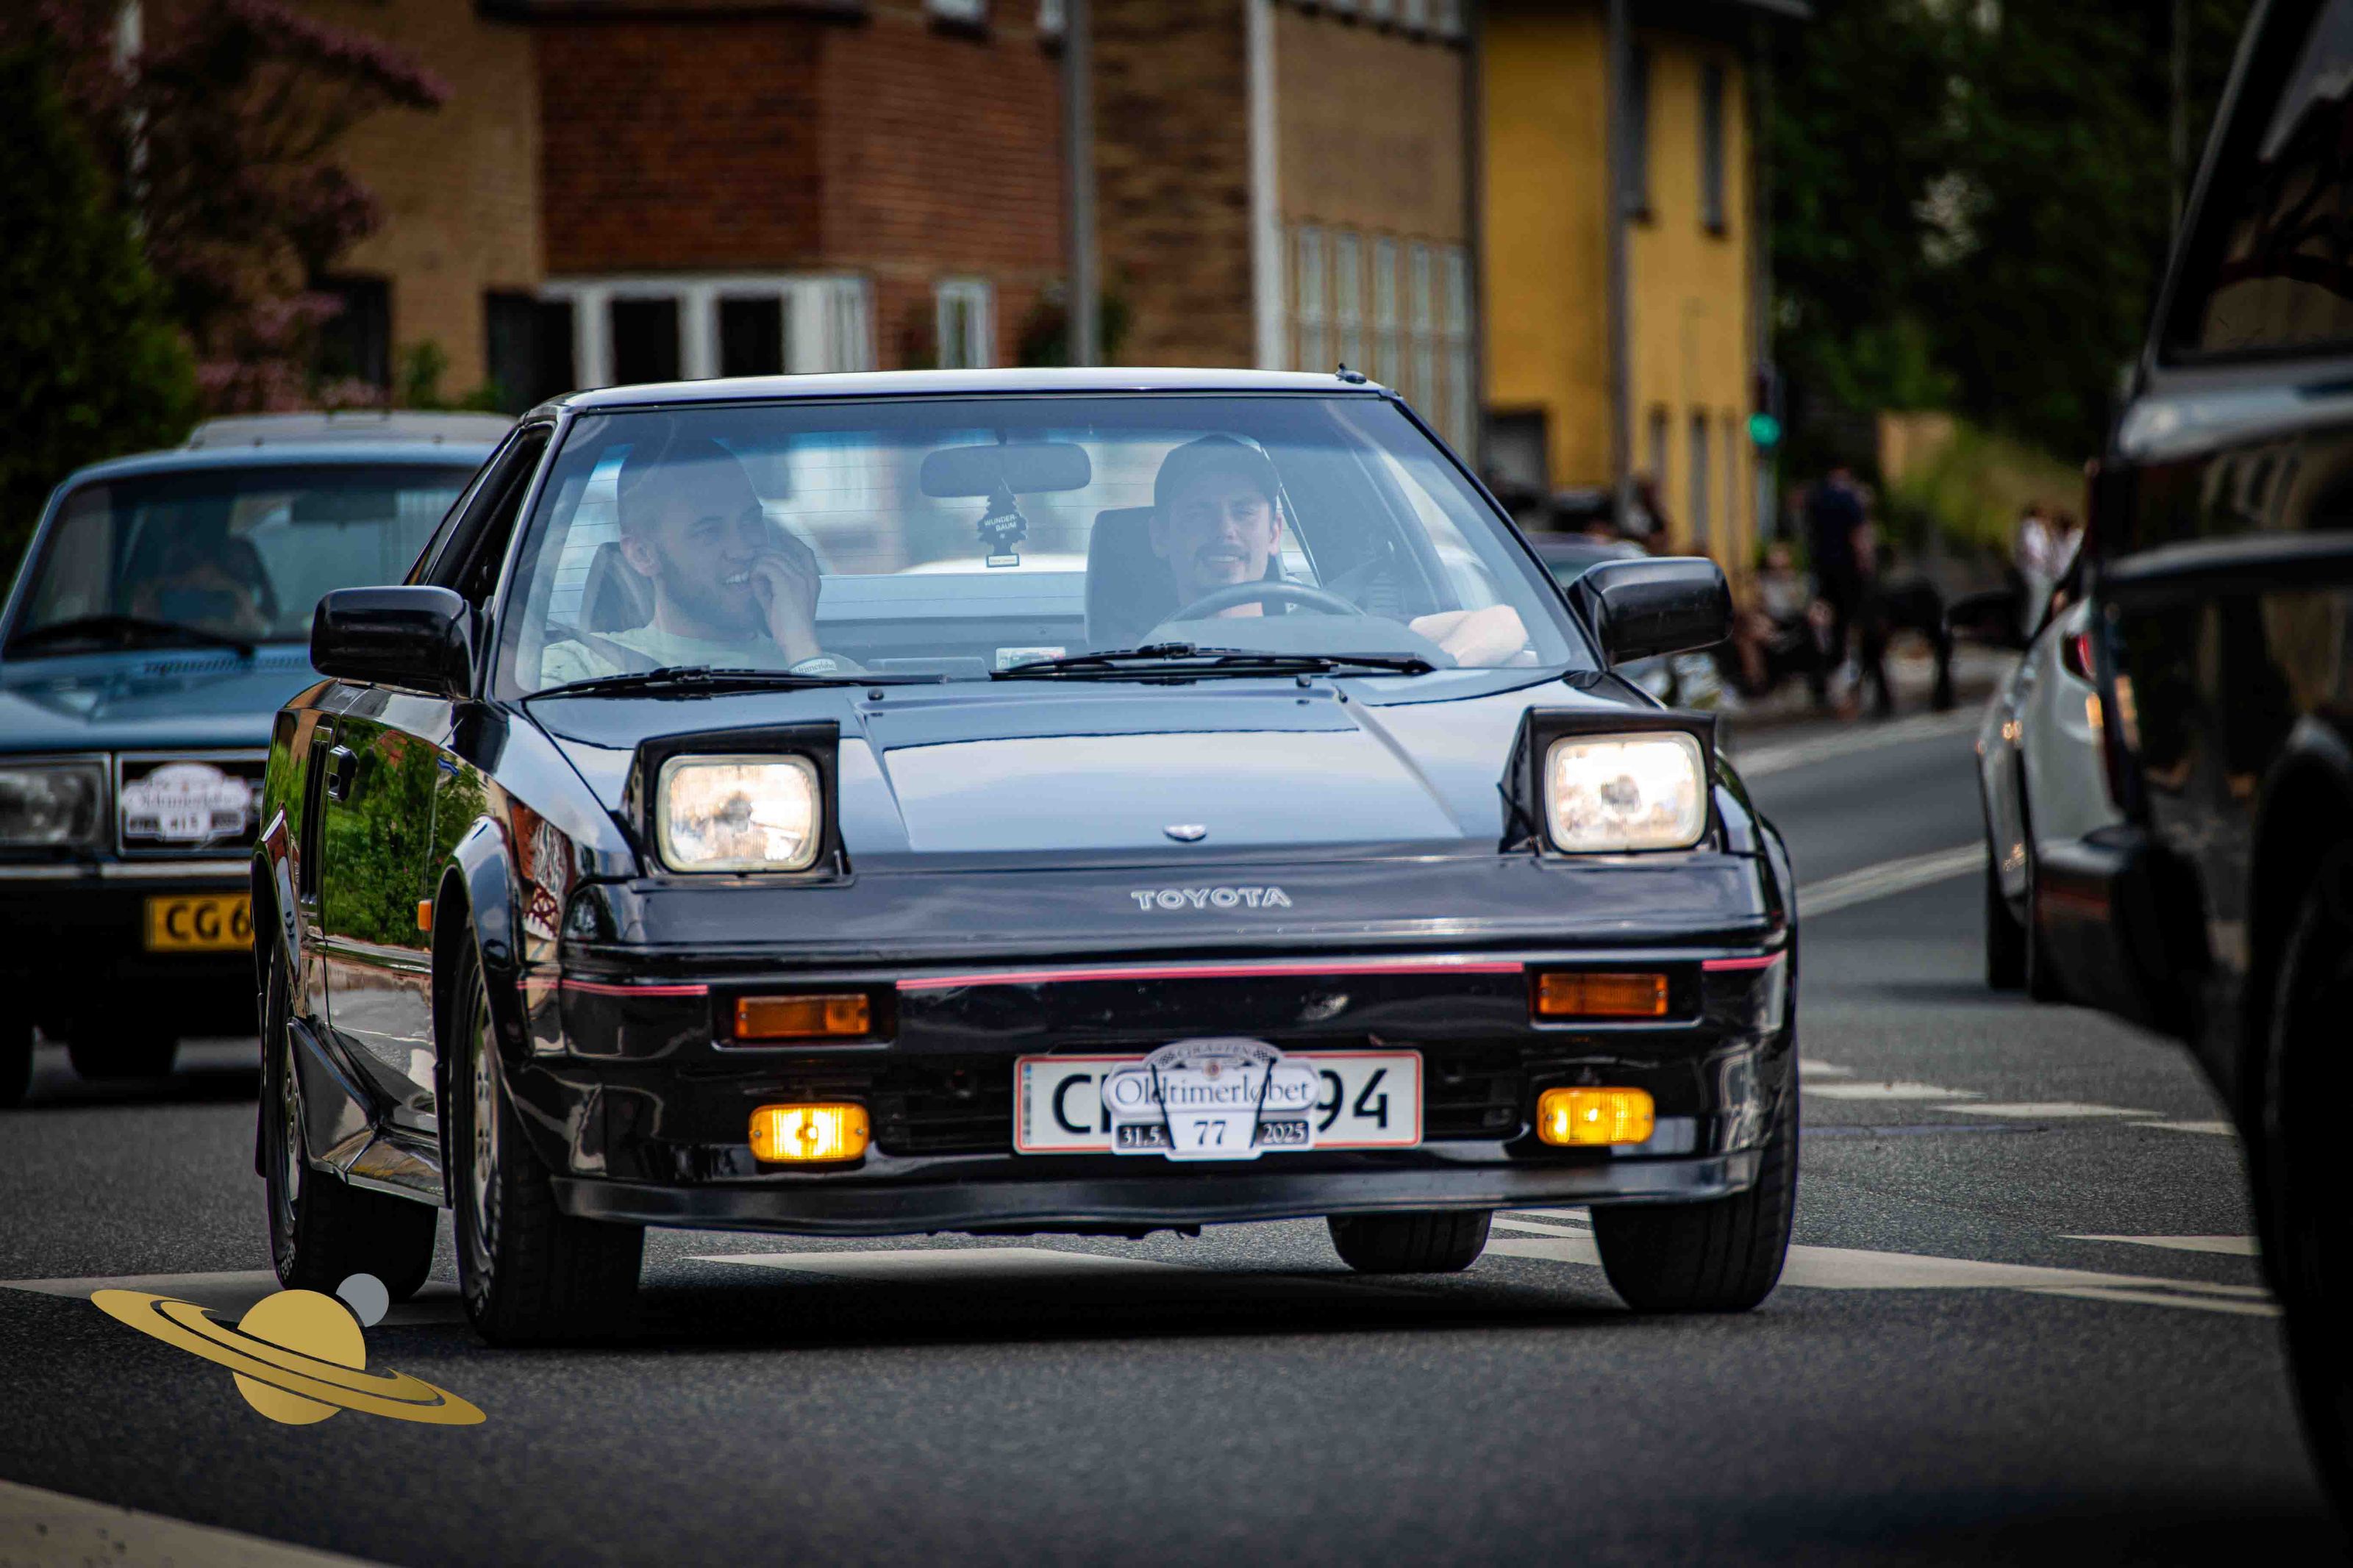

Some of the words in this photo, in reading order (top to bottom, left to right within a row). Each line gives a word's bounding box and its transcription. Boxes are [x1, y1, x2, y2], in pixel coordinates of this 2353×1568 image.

[984, 514, 1018, 526] WUNDER-
[995, 521, 1017, 531] BAUM
[1131, 887, 1293, 911] TOYOTA
[165, 901, 221, 940] CG
[1315, 1068, 1388, 1133] 94
[1193, 1119, 1226, 1145] 77
[1263, 1122, 1307, 1145] 2025
